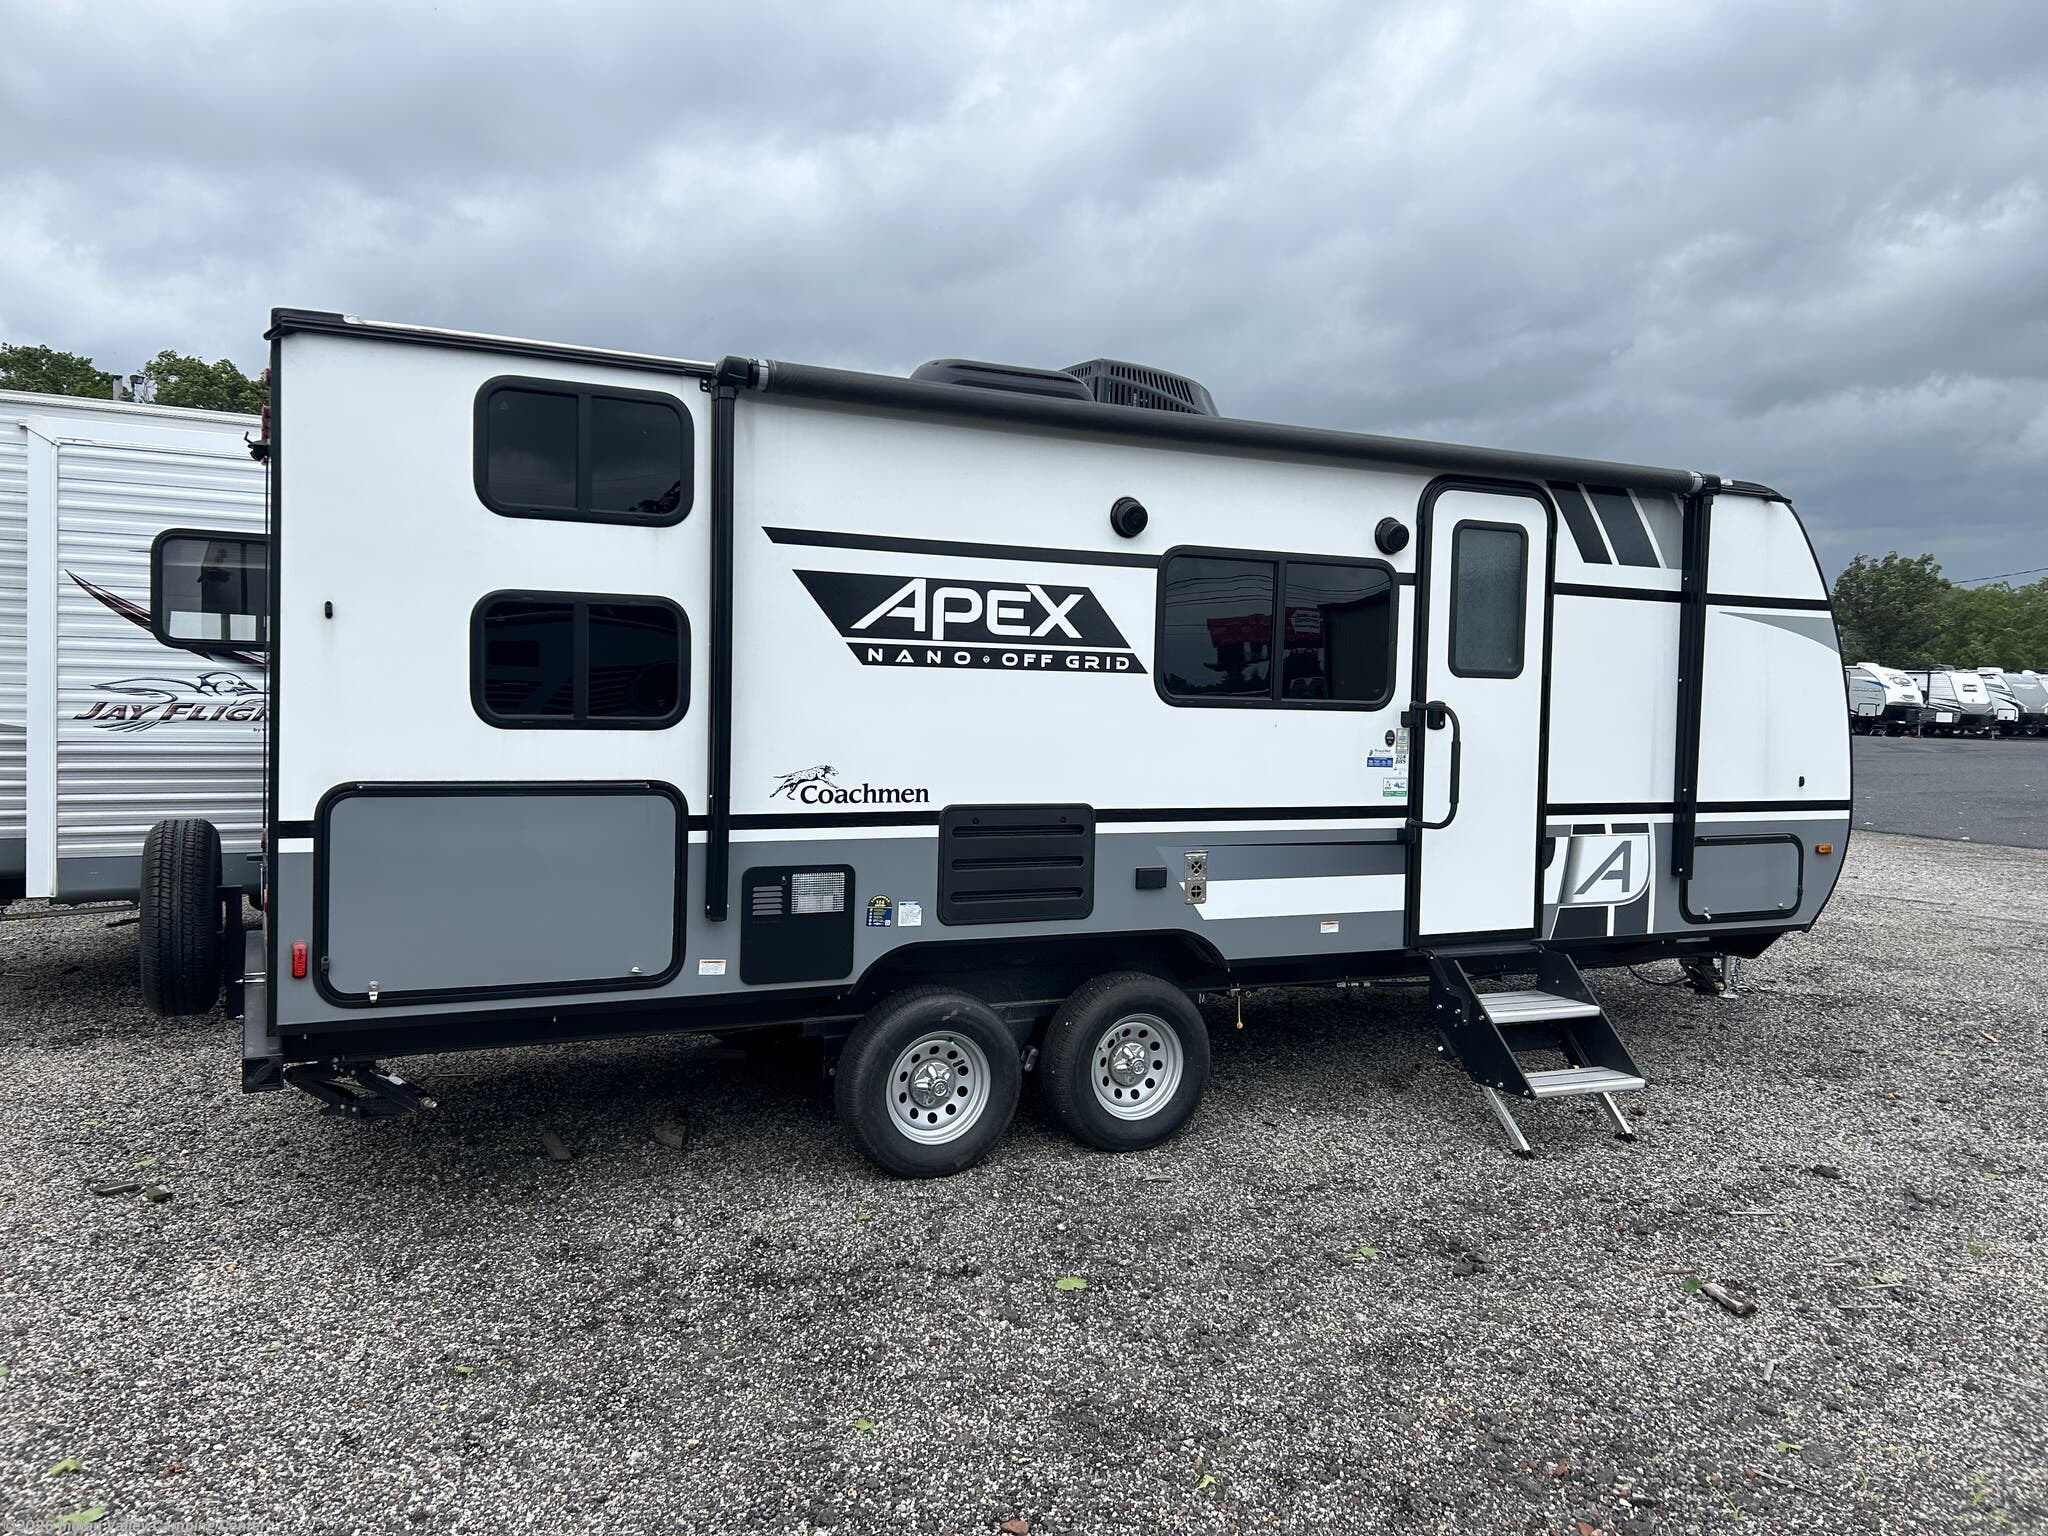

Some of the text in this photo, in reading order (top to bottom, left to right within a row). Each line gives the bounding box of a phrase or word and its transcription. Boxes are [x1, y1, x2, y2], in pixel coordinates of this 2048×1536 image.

[850, 578, 1084, 641] APEX
[867, 647, 1130, 671] NANO OFF GRID
[73, 702, 160, 721] JAY
[800, 783, 930, 805] Coachmen
[1573, 840, 1631, 895] A
